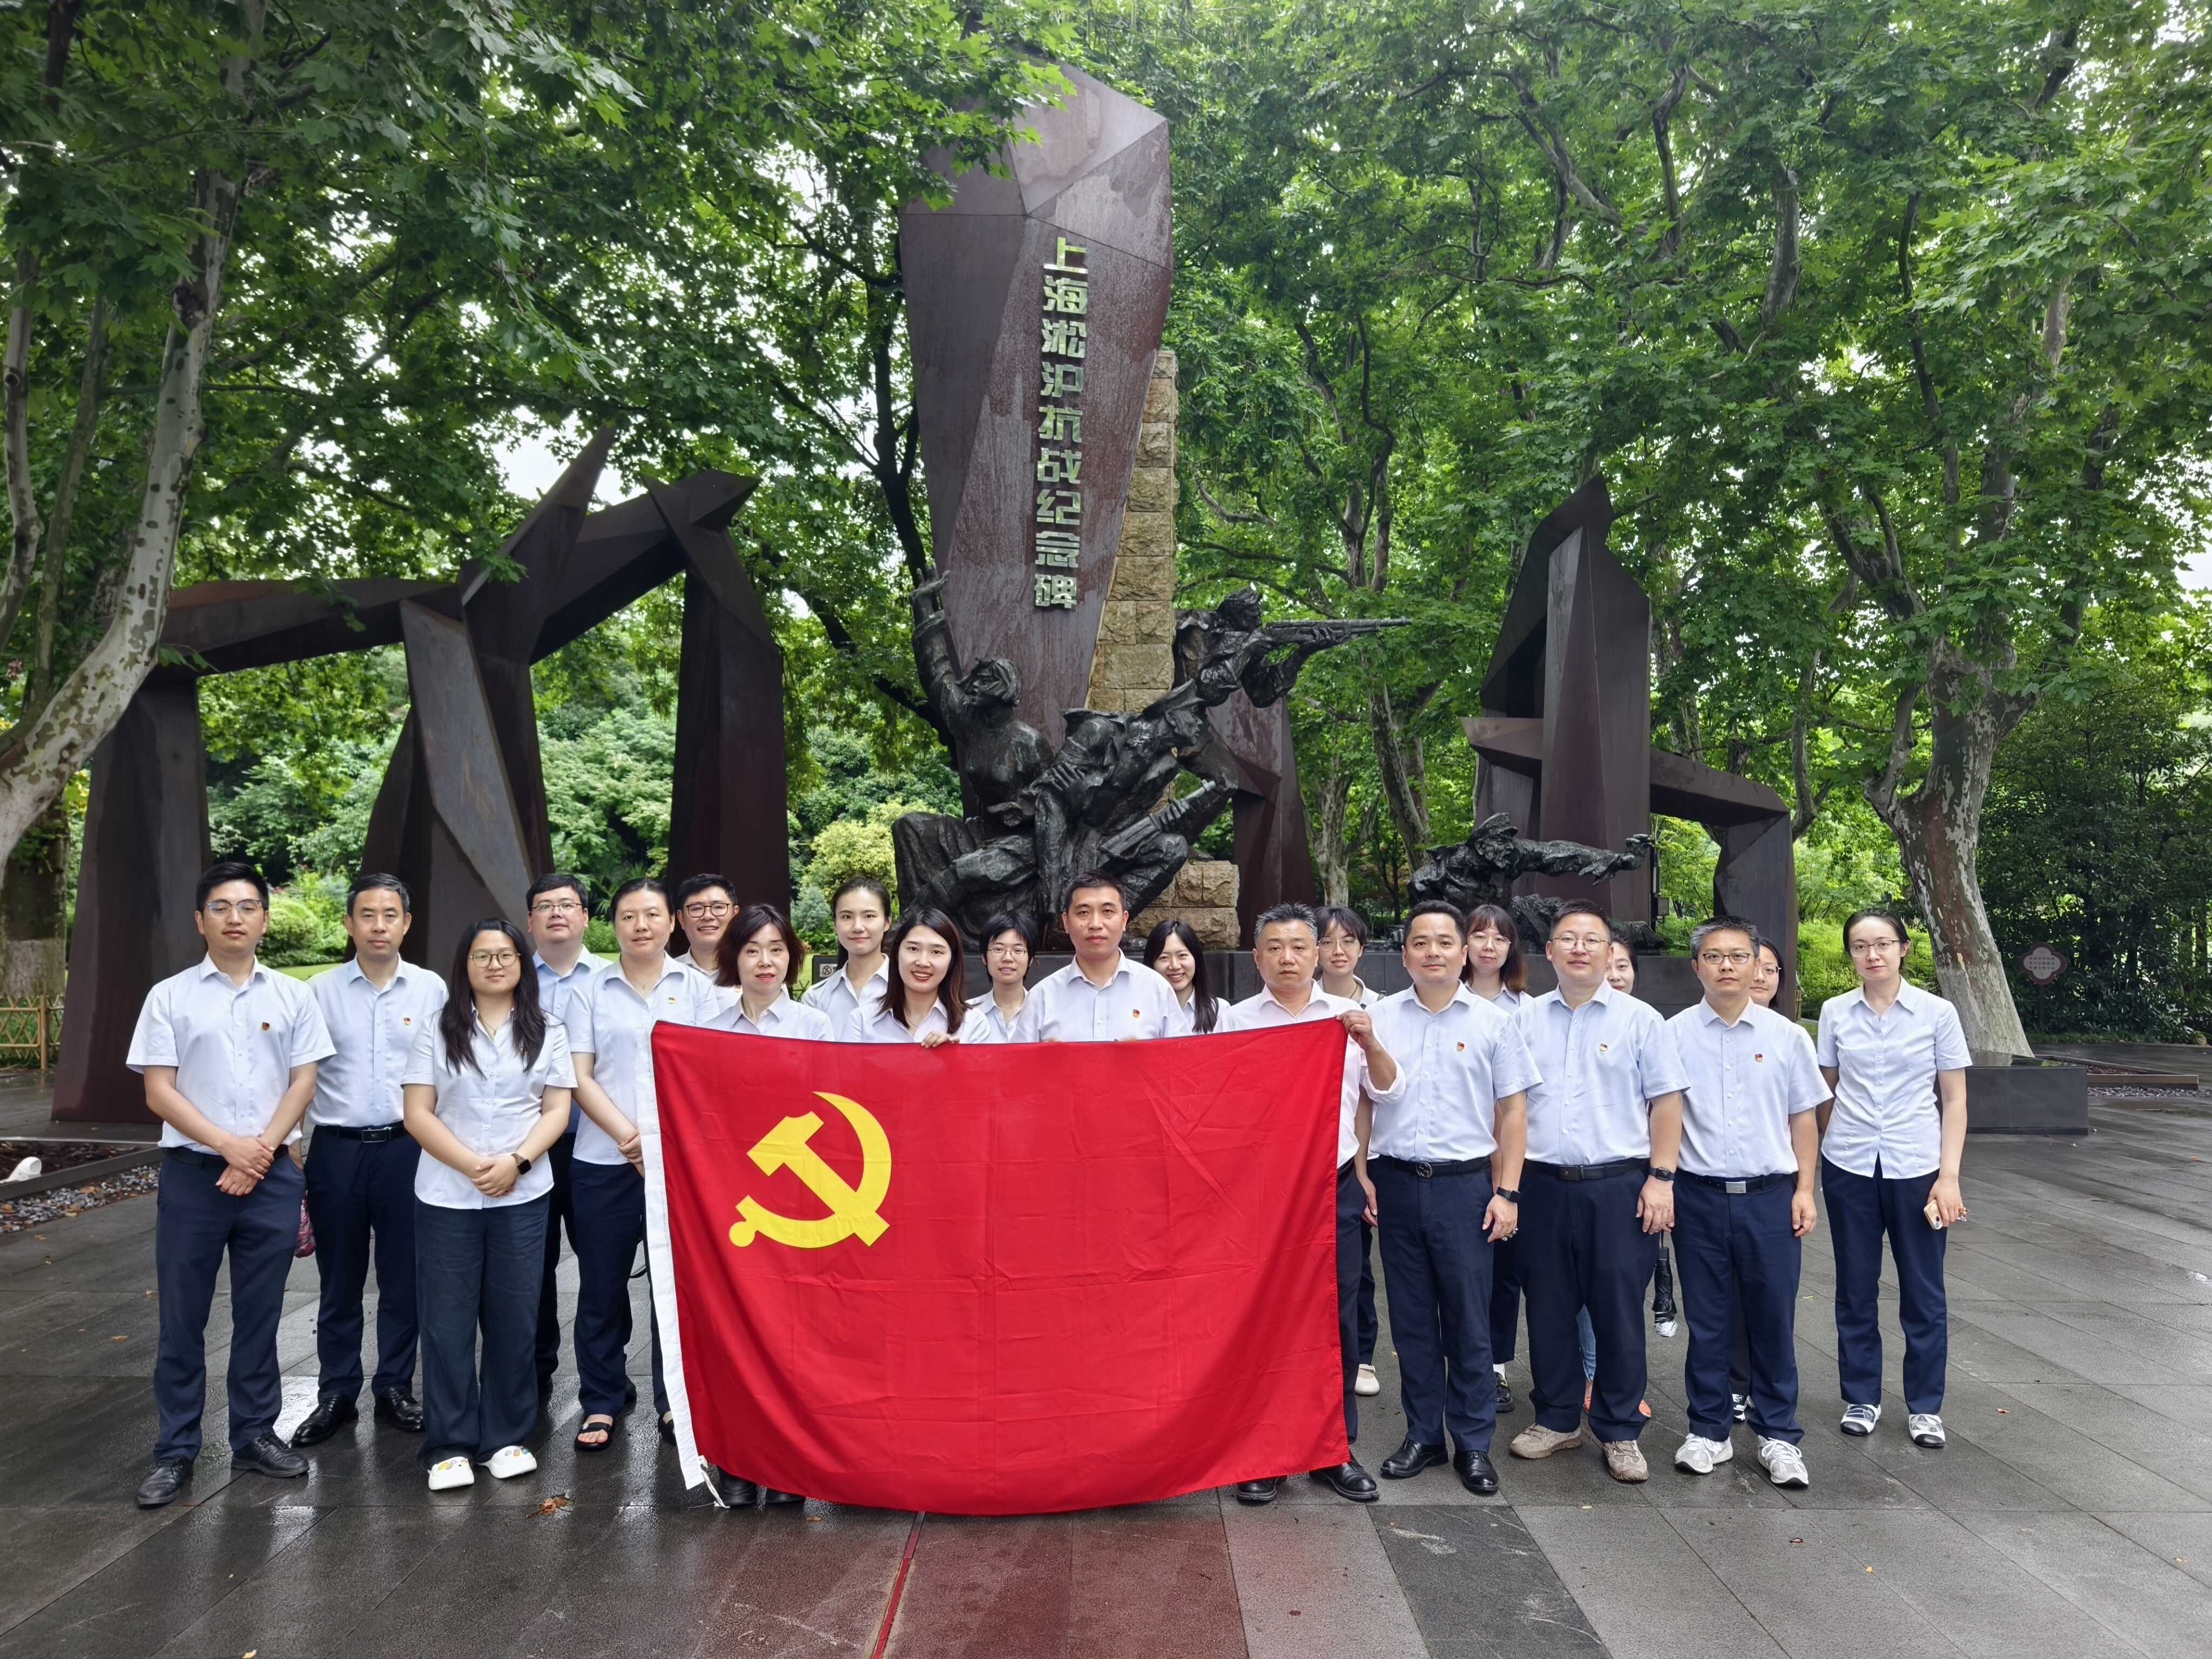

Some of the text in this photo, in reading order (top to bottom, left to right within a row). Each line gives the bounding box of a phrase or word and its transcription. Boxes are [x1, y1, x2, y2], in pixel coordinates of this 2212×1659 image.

[1035, 237, 1089, 609] 上海淞沪抗战纪念碑
